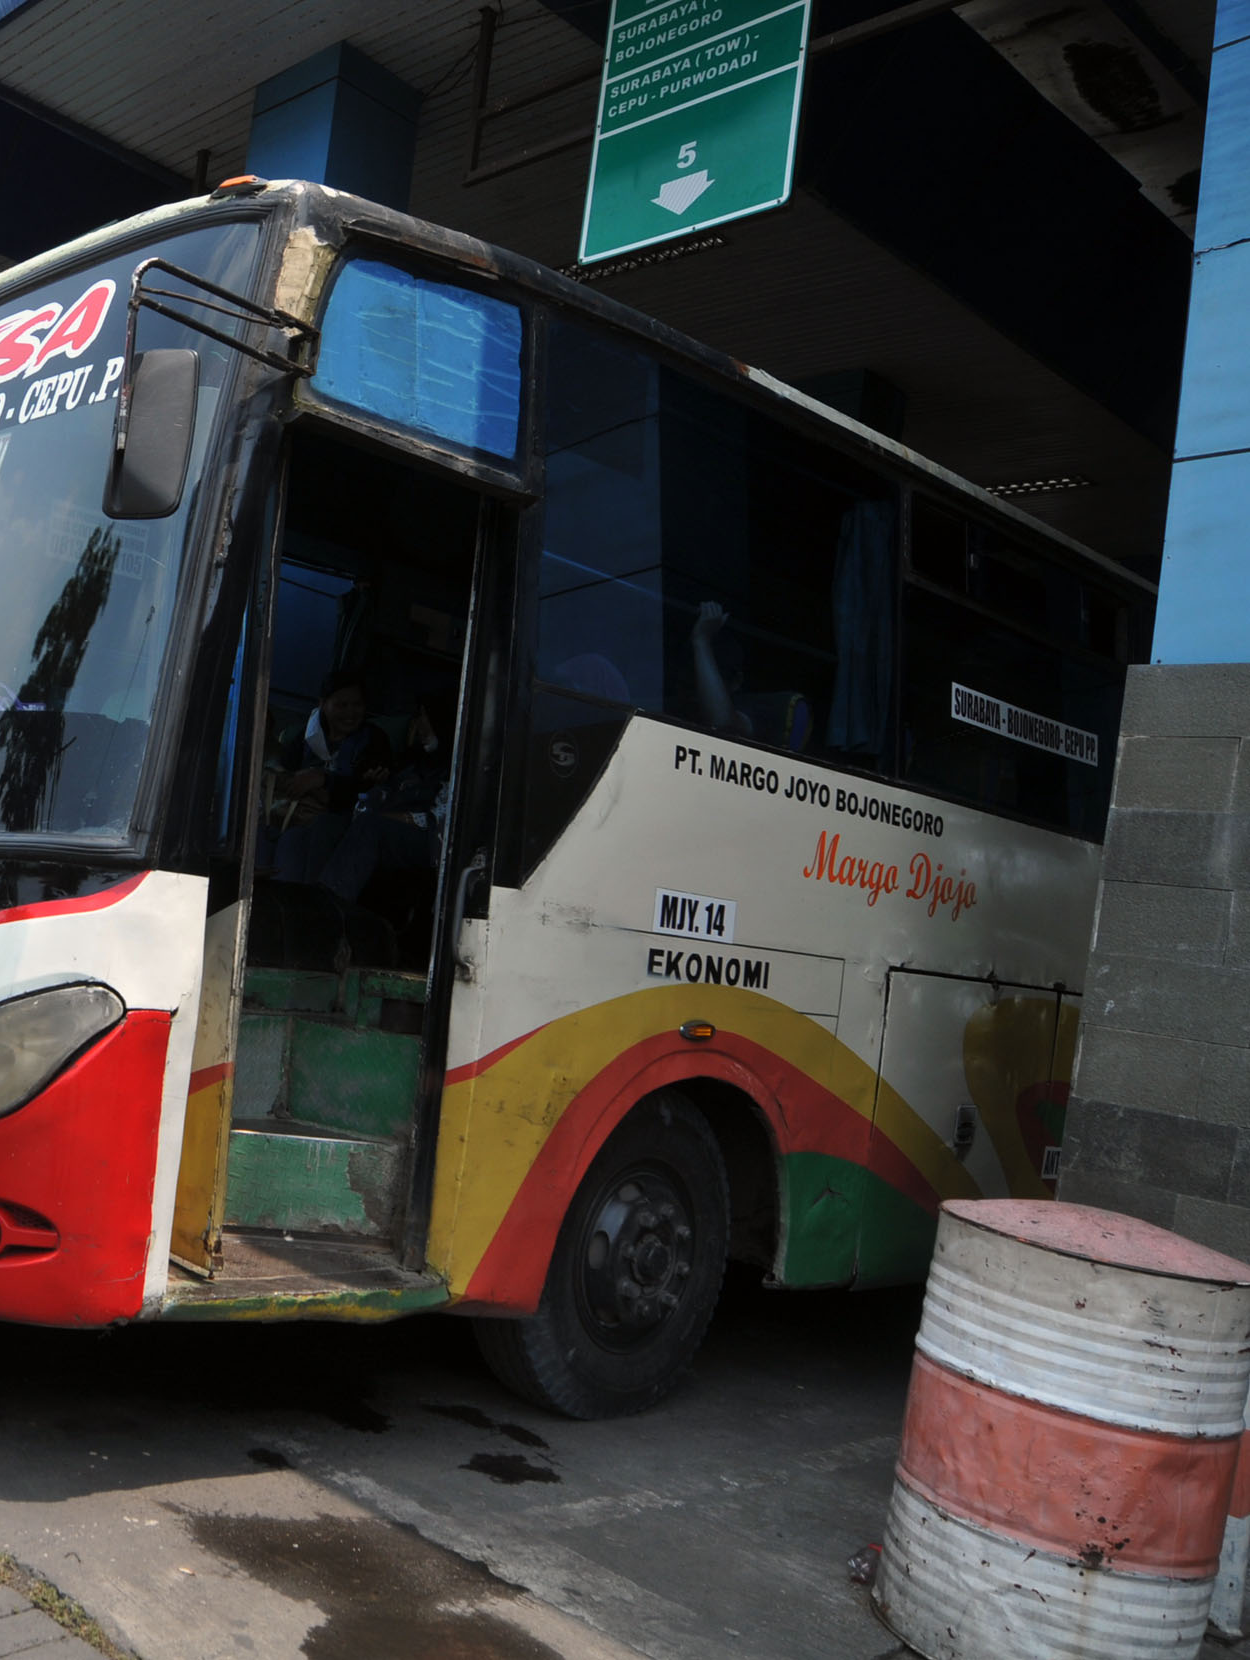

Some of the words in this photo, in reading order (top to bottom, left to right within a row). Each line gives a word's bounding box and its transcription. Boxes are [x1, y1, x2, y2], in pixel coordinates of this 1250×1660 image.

[615, 9, 723, 63] BOJONEGORO
[617, 0, 698, 43] SURABAYA
[608, 94, 648, 118] CEPU
[660, 50, 758, 98] PURWODADI
[610, 57, 691, 99] SURABAYA
[676, 140, 697, 169] 5
[18, 364, 94, 424] CEPU
[954, 687, 1000, 730] SURABAYA
[1064, 729, 1085, 758] CEPU
[674, 745, 703, 775] PT.
[709, 755, 779, 794] MARGO
[784, 775, 831, 808] JOYO
[835, 788, 944, 838] BOJONEGORO
[803, 830, 899, 907] Margo
[906, 852, 977, 922] Djojo
[659, 894, 699, 933] MJY.
[705, 902, 726, 937] 14
[647, 948, 770, 990] EKONOMI
